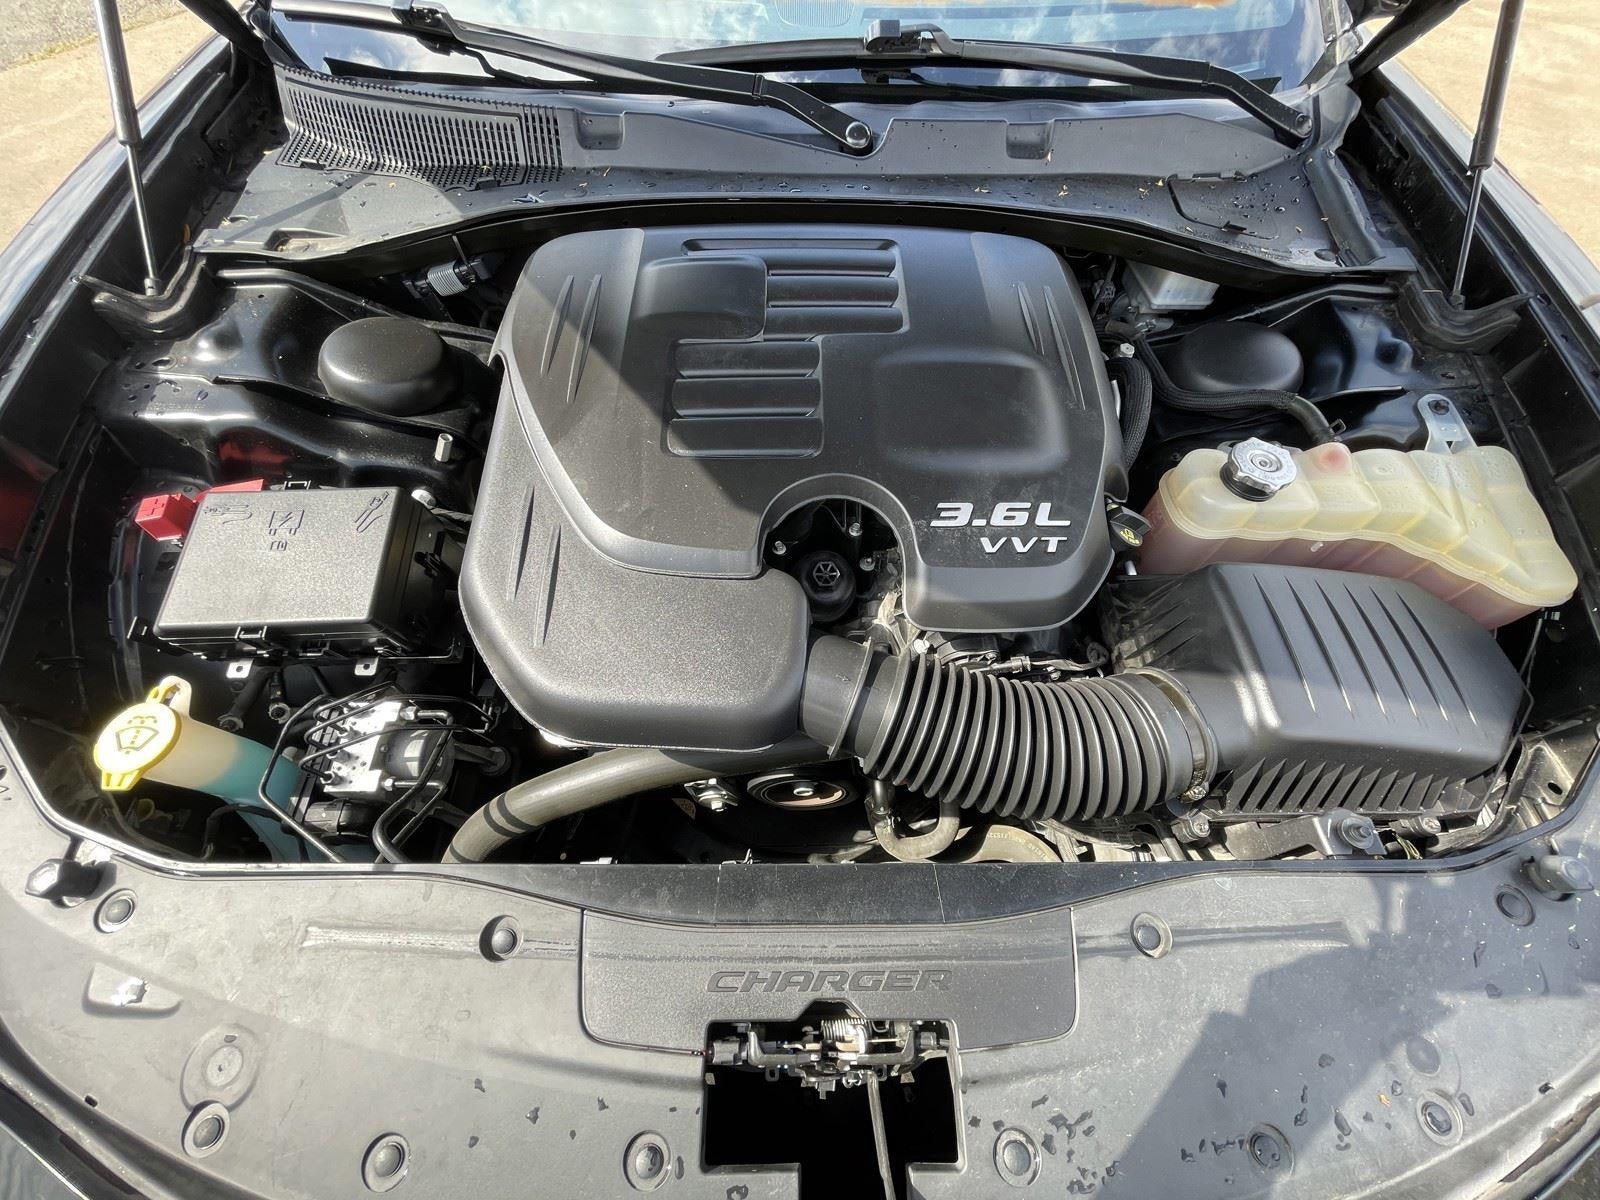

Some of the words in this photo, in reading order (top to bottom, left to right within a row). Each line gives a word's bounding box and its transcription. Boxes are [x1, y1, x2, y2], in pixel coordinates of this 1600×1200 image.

[930, 502, 1071, 527] 3.6L
[980, 536, 1068, 553] VVT
[707, 970, 952, 993] CHARGER
